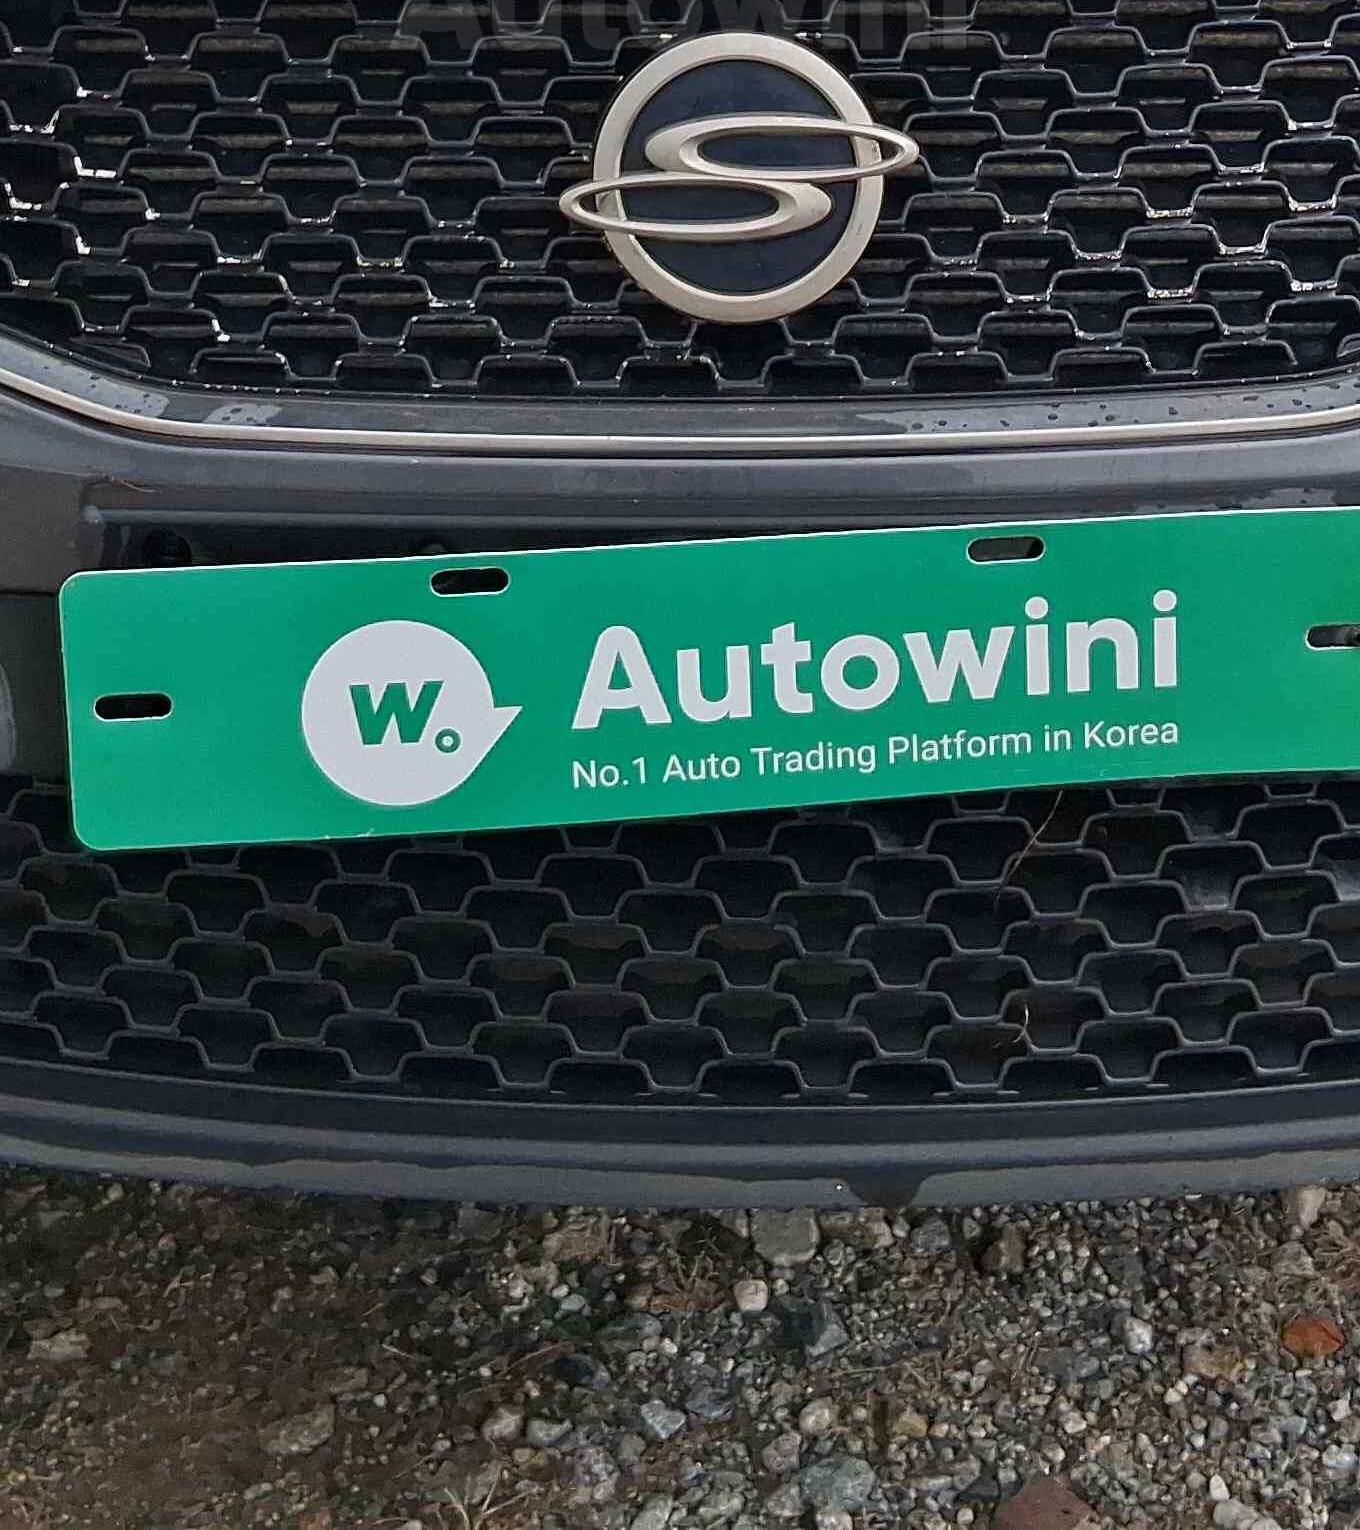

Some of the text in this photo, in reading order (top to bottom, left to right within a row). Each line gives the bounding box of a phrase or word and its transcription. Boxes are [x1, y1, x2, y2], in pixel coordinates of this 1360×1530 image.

[571, 588, 1179, 730] Autowini
[572, 721, 1180, 789] No.1 Auto Trading Platform in Korea
